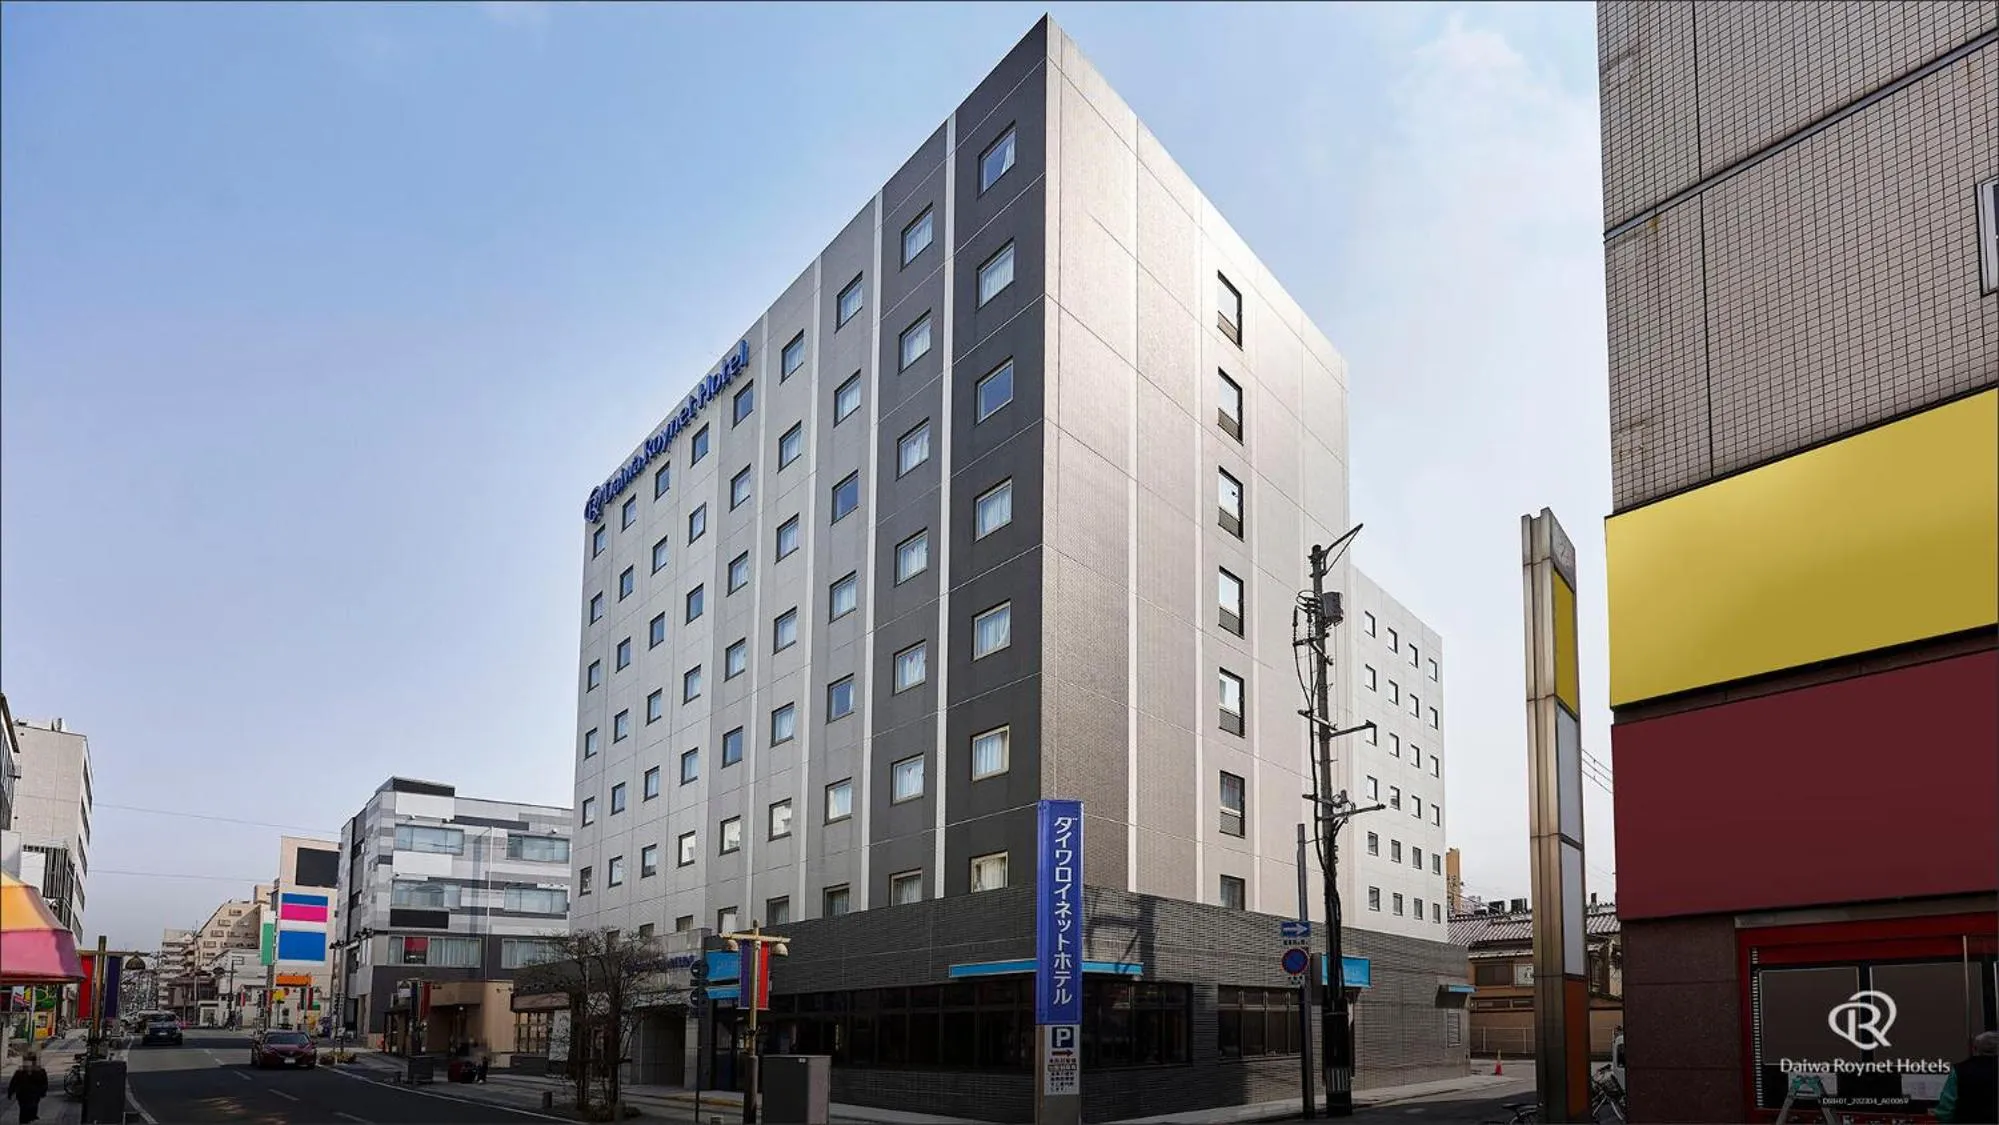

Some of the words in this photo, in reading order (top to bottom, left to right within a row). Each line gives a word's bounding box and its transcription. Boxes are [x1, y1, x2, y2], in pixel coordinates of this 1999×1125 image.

[697, 339, 749, 409] Hotel
[1053, 816, 1078, 1005] ダイワロイネットホテル
[1056, 1028, 1071, 1047] P
